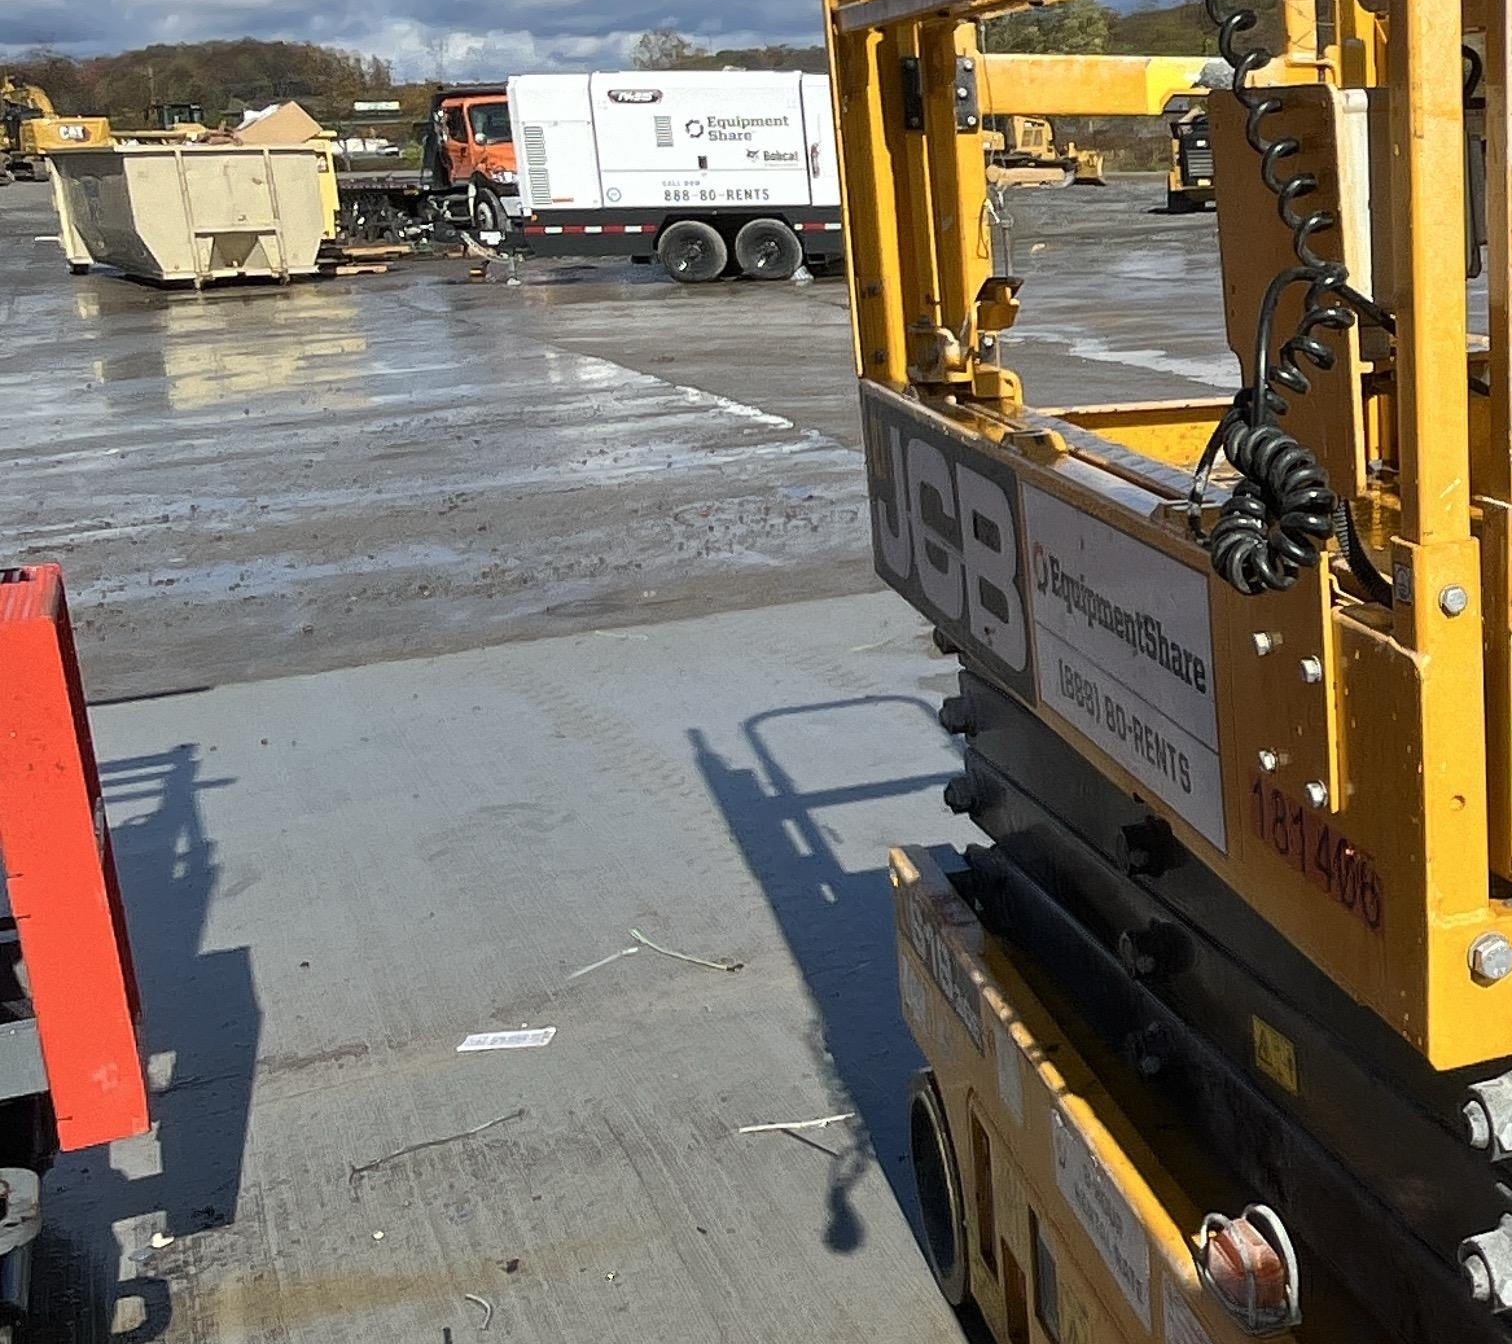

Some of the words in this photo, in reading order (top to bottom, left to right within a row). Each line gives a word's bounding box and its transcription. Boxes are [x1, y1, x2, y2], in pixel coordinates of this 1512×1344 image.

[707, 115, 790, 130] Equipment
[708, 130, 752, 142] Share
[878, 424, 1028, 674] JCB
[1048, 554, 1207, 695] EquipmentShare
[1058, 657, 1101, 724] (888)
[1104, 694, 1192, 795] 80-RENTS
